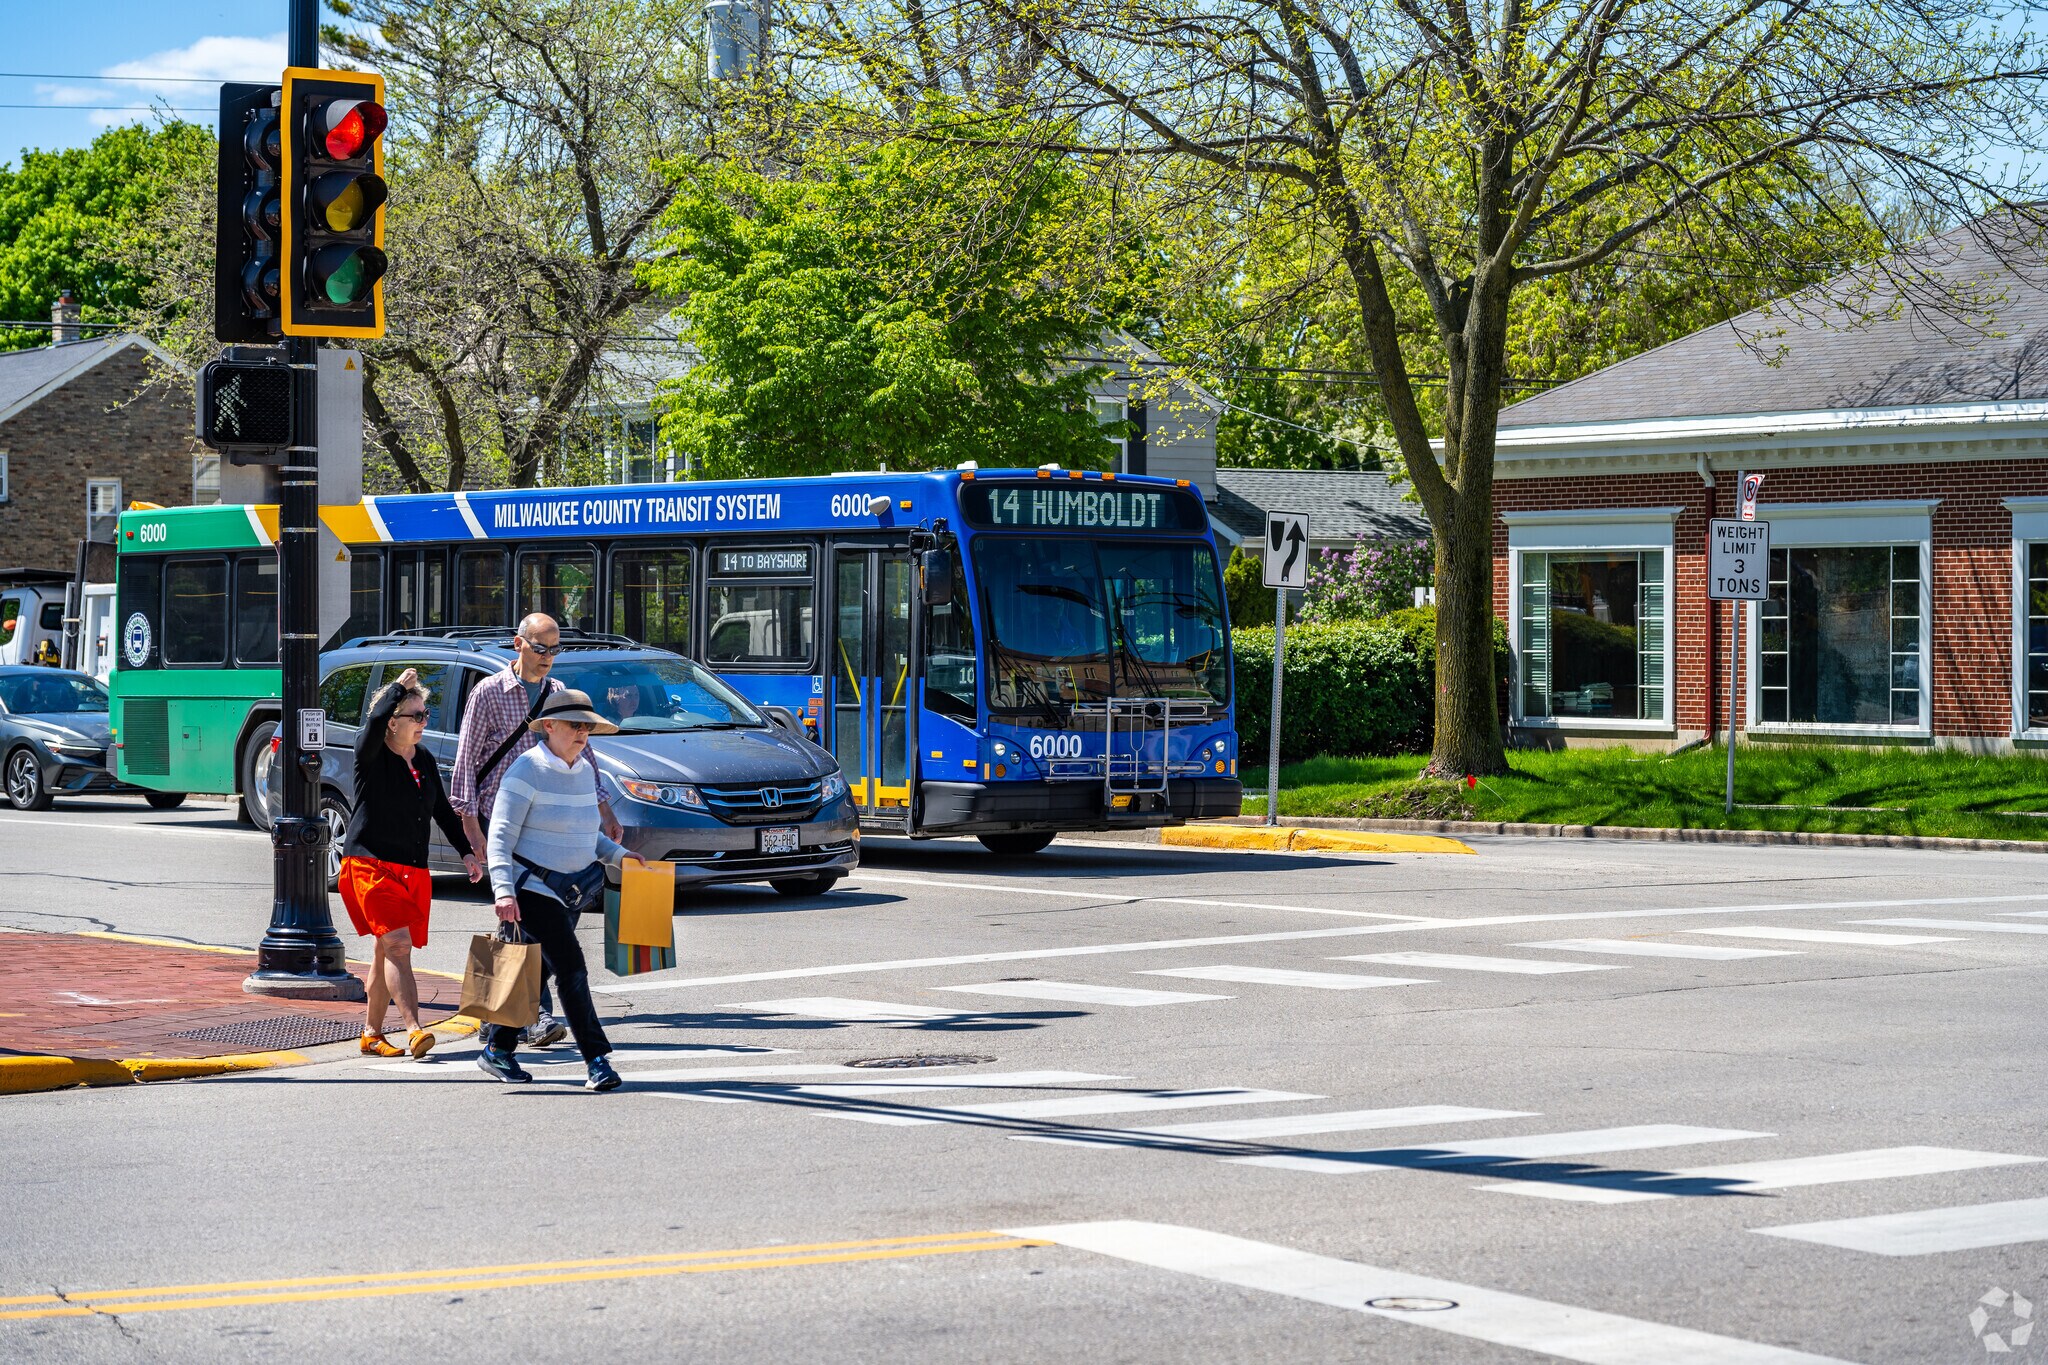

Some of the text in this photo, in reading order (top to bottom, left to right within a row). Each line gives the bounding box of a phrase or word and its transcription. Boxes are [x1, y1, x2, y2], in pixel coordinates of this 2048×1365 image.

[494, 493, 781, 528] MILWAUKEE COUNTY TRANSIT SYSTEM
[831, 493, 871, 518] 6000
[988, 488, 1161, 528] 14 HUMBOLDT
[140, 522, 167, 543] 6000
[1717, 526, 1765, 540] WEIGHT
[1723, 542, 1756, 555] LIMIT
[723, 553, 807, 571] 14 TO BAYSHORE
[1734, 558, 1745, 574] 3
[1717, 578, 1760, 594] TONS
[1030, 734, 1082, 759] 6000
